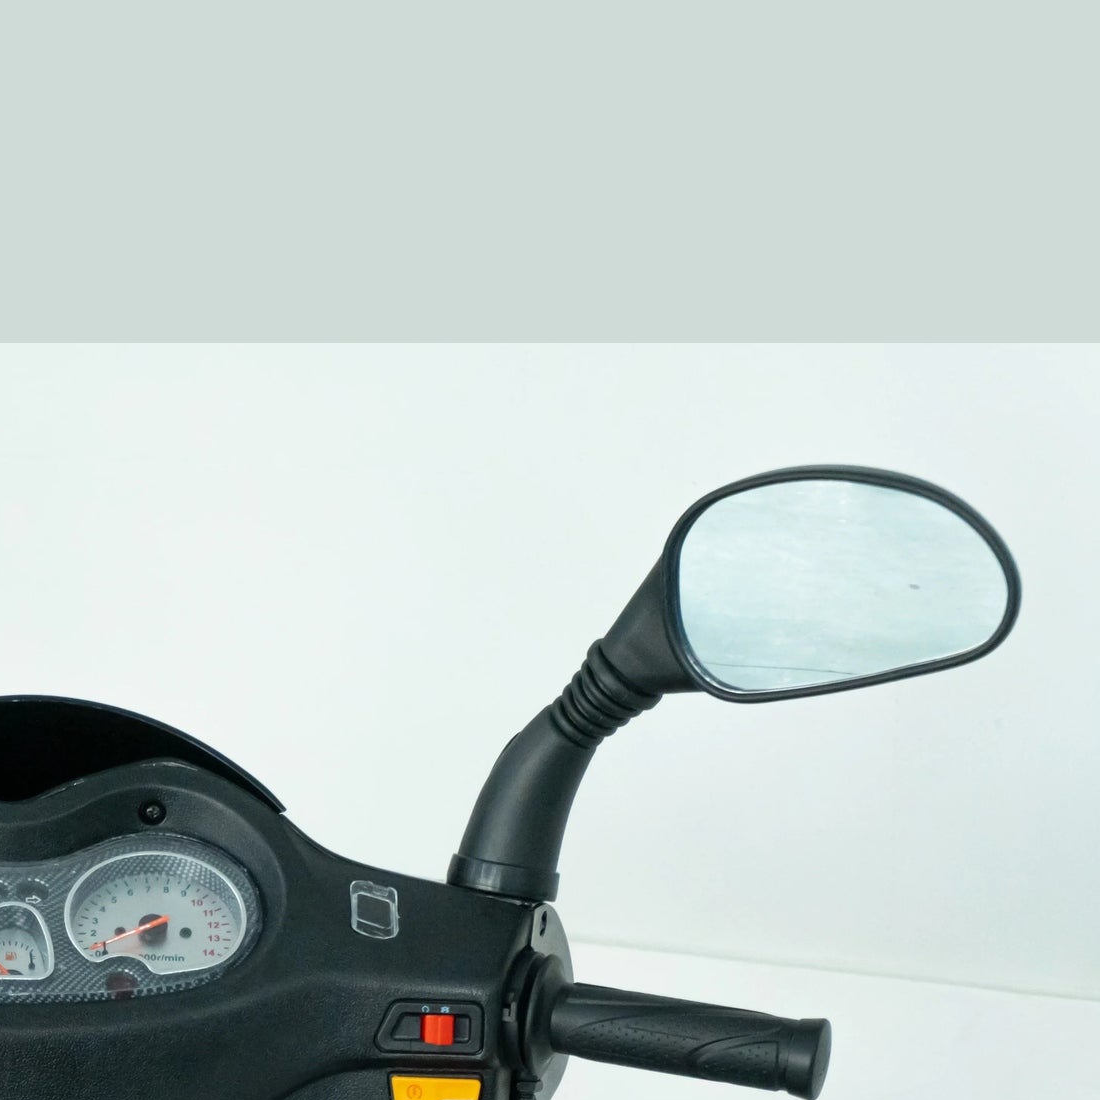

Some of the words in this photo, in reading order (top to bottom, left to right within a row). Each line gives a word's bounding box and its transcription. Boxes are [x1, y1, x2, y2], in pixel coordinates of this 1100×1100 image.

[127, 888, 134, 896] 6
[145, 885, 151, 893] 7
[163, 886, 170, 894] 8
[111, 896, 117, 904] 5
[191, 899, 204, 907] 10
[203, 909, 213, 917] 11
[92, 917, 99, 925] 3
[207, 921, 220, 929] 12
[90, 929, 97, 937] 2
[208, 934, 220, 942] 13
[202, 948, 215, 957] 14
